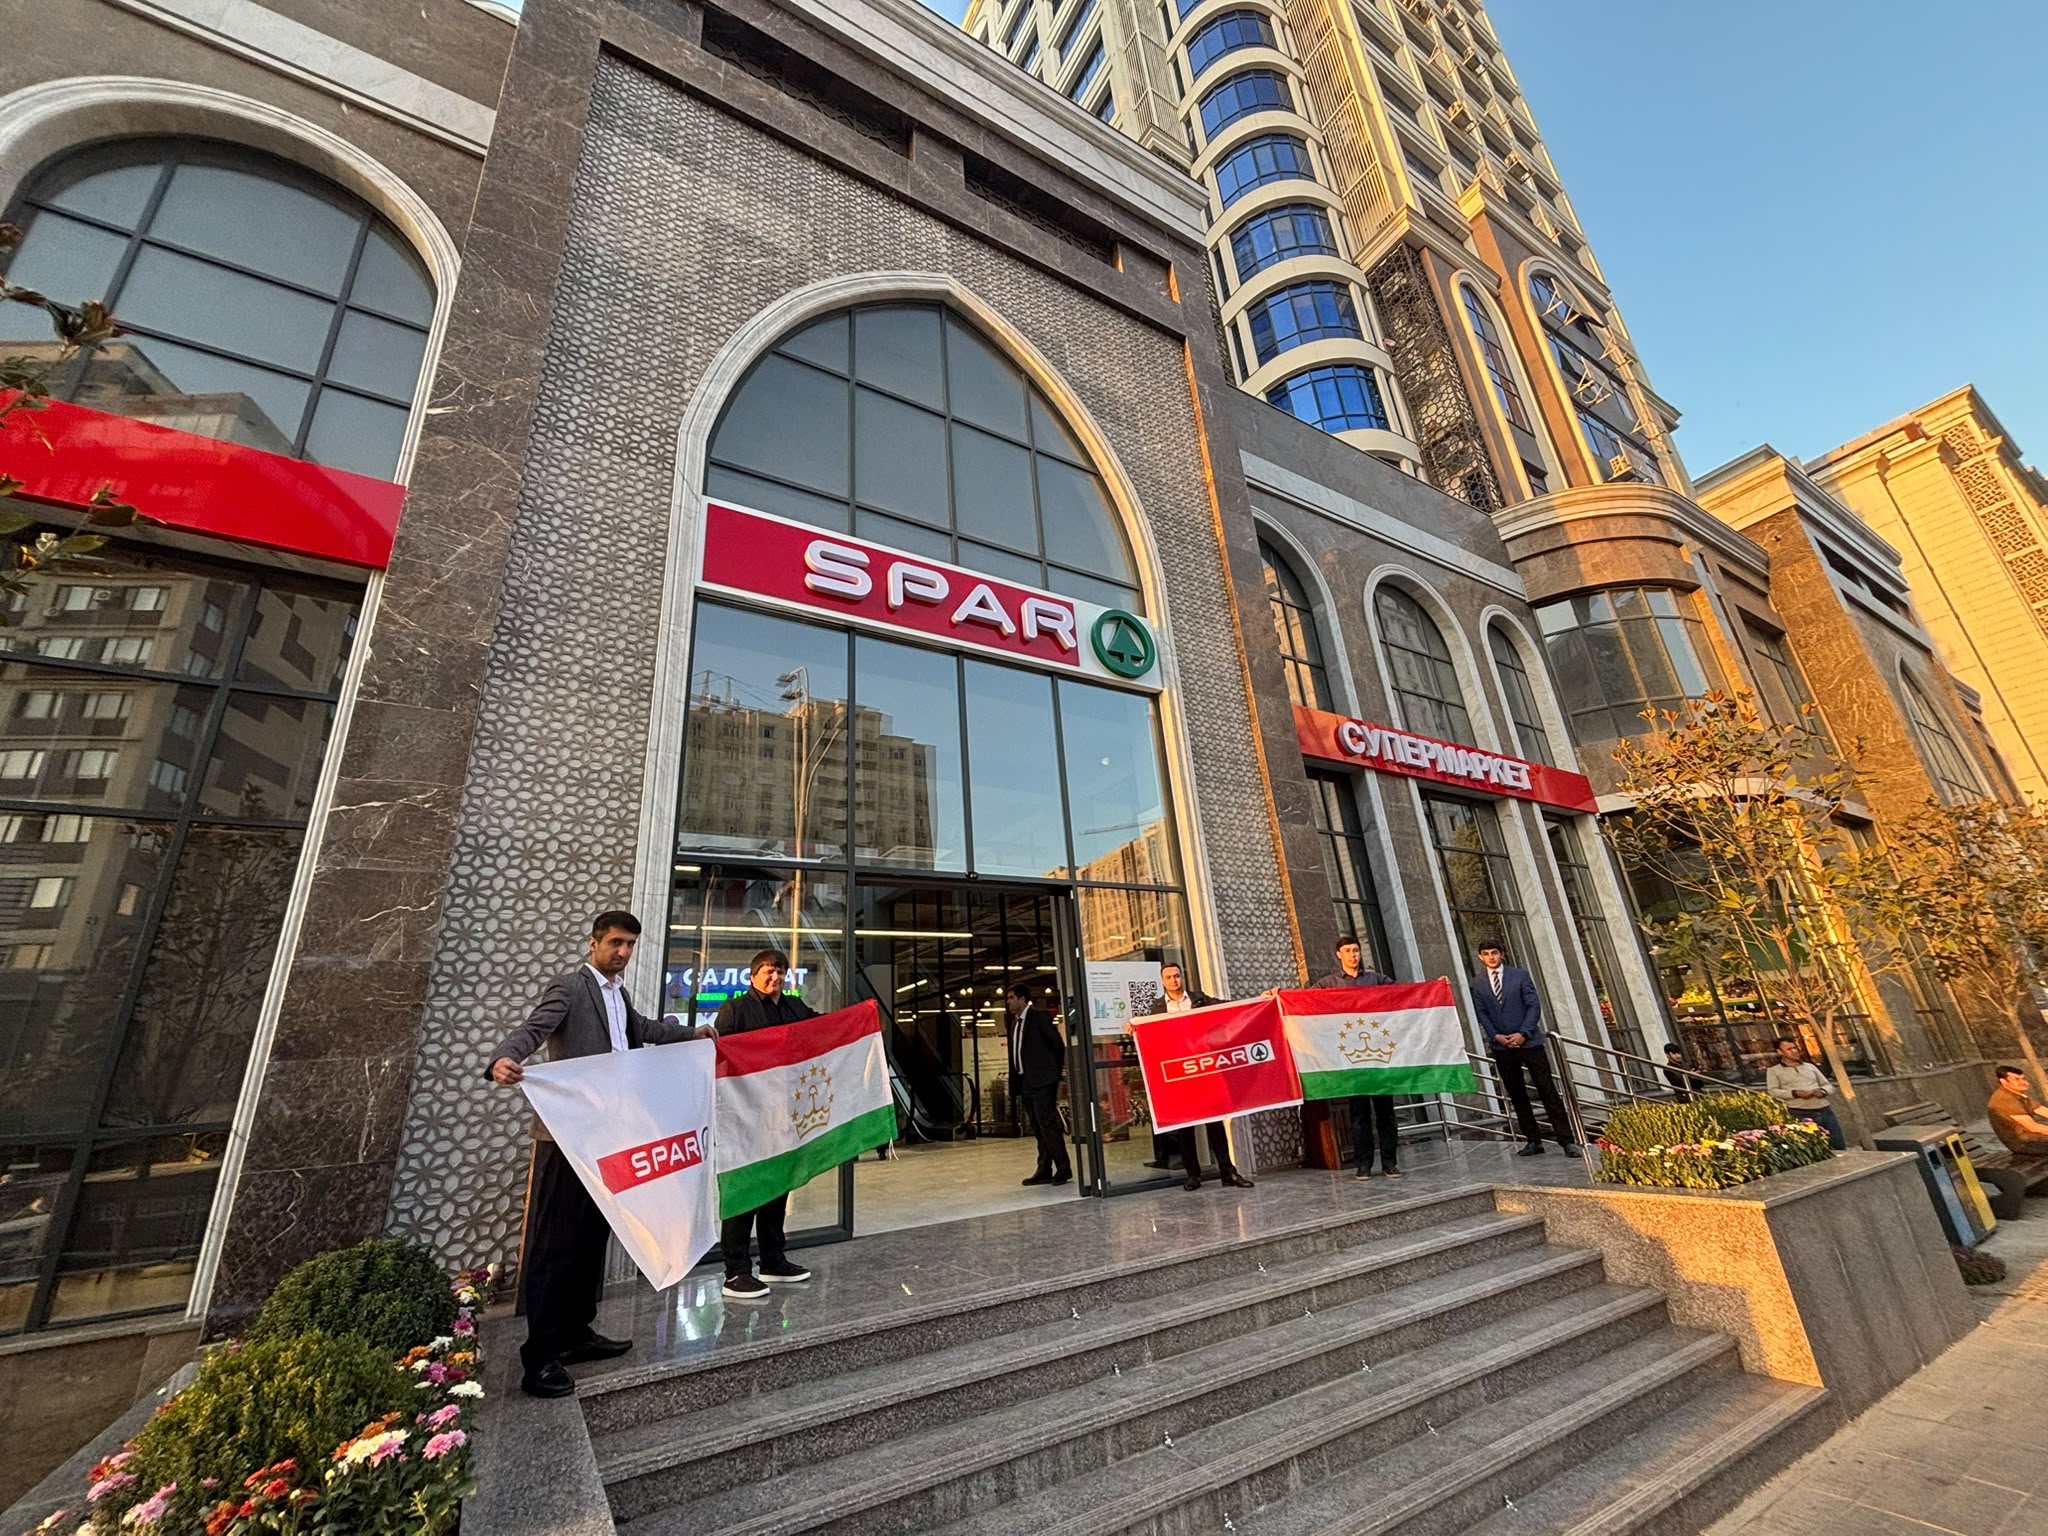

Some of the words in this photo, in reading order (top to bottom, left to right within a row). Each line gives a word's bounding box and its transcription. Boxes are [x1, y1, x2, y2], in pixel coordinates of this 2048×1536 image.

[804, 540, 1077, 650] SPAR
[1338, 721, 1532, 790] СУПЕРМАРКЕТ
[683, 967, 808, 986] САЛОАТ
[1182, 1050, 1247, 1074] SPAR
[631, 1136, 700, 1178] SPAR
